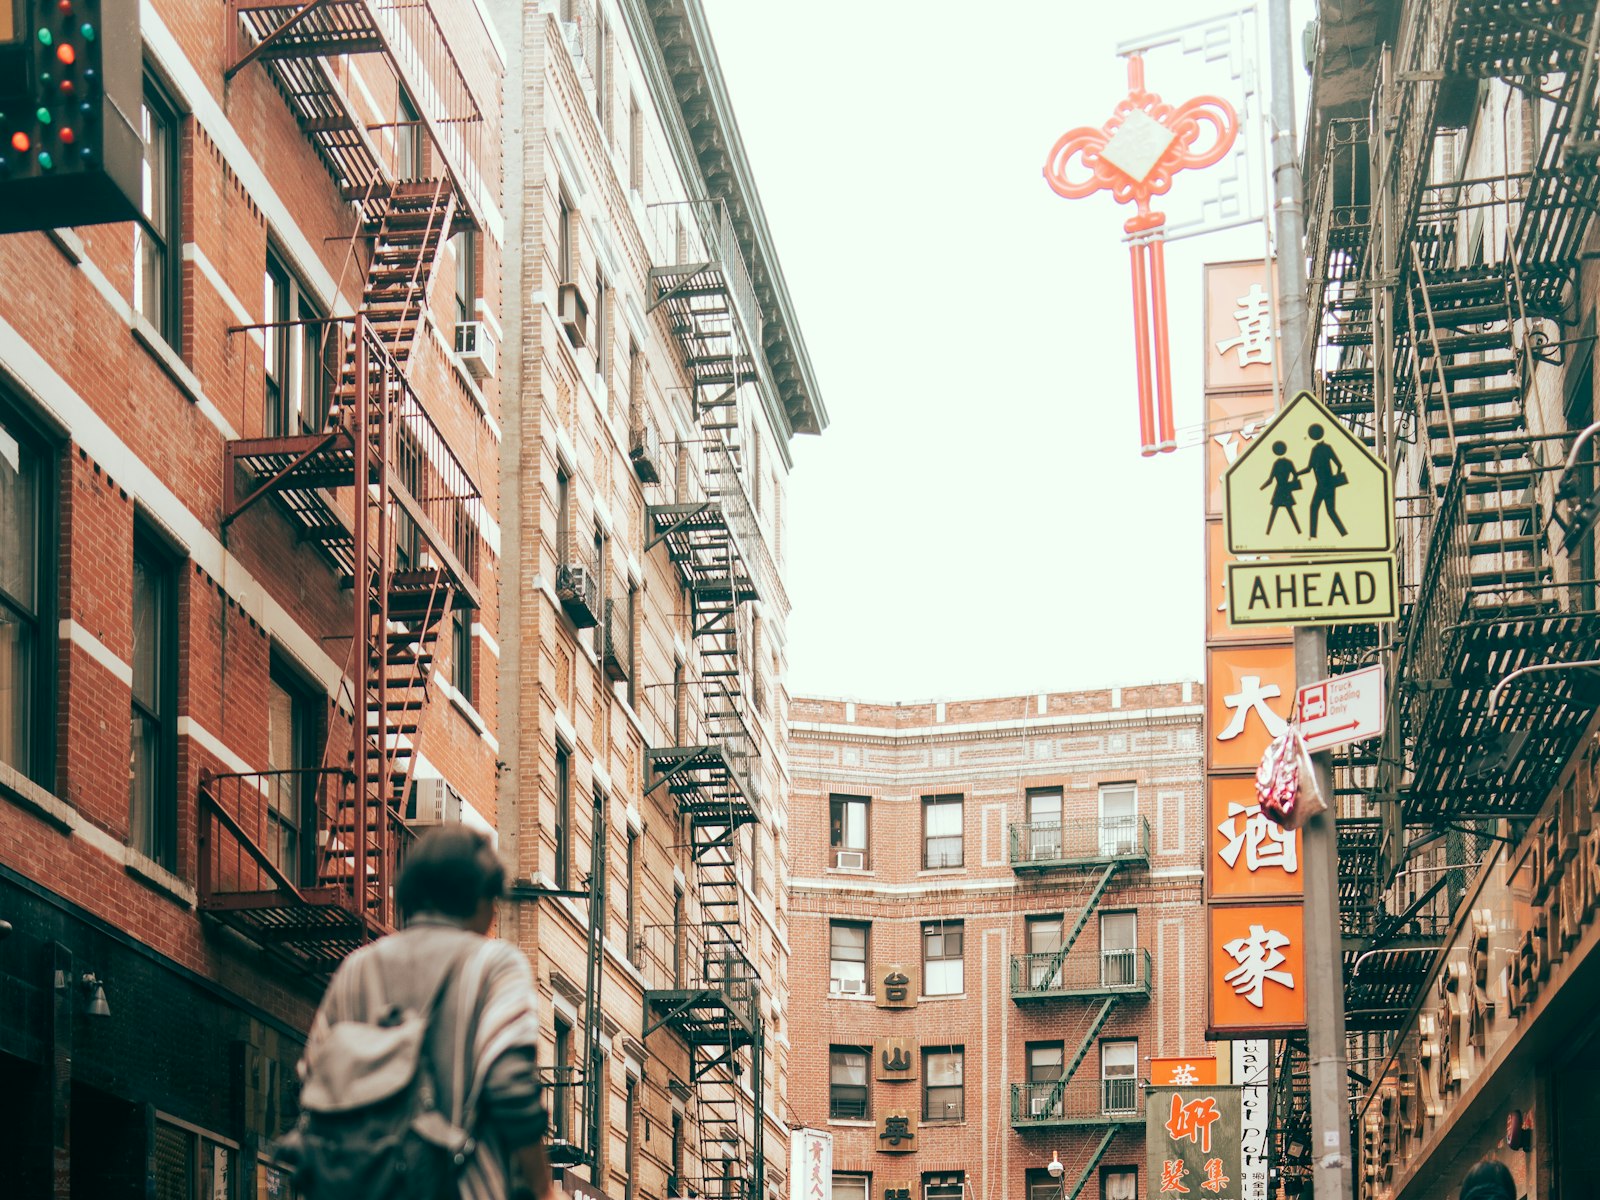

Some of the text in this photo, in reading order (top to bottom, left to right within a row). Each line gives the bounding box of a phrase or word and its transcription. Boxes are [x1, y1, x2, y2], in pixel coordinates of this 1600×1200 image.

[1247, 570, 1377, 610] AHEAD
[1330, 681, 1352, 693] Truck
[1330, 690, 1361, 704] Loading
[1330, 704, 1347, 715] Only
[1242, 1040, 1260, 1074] uan
